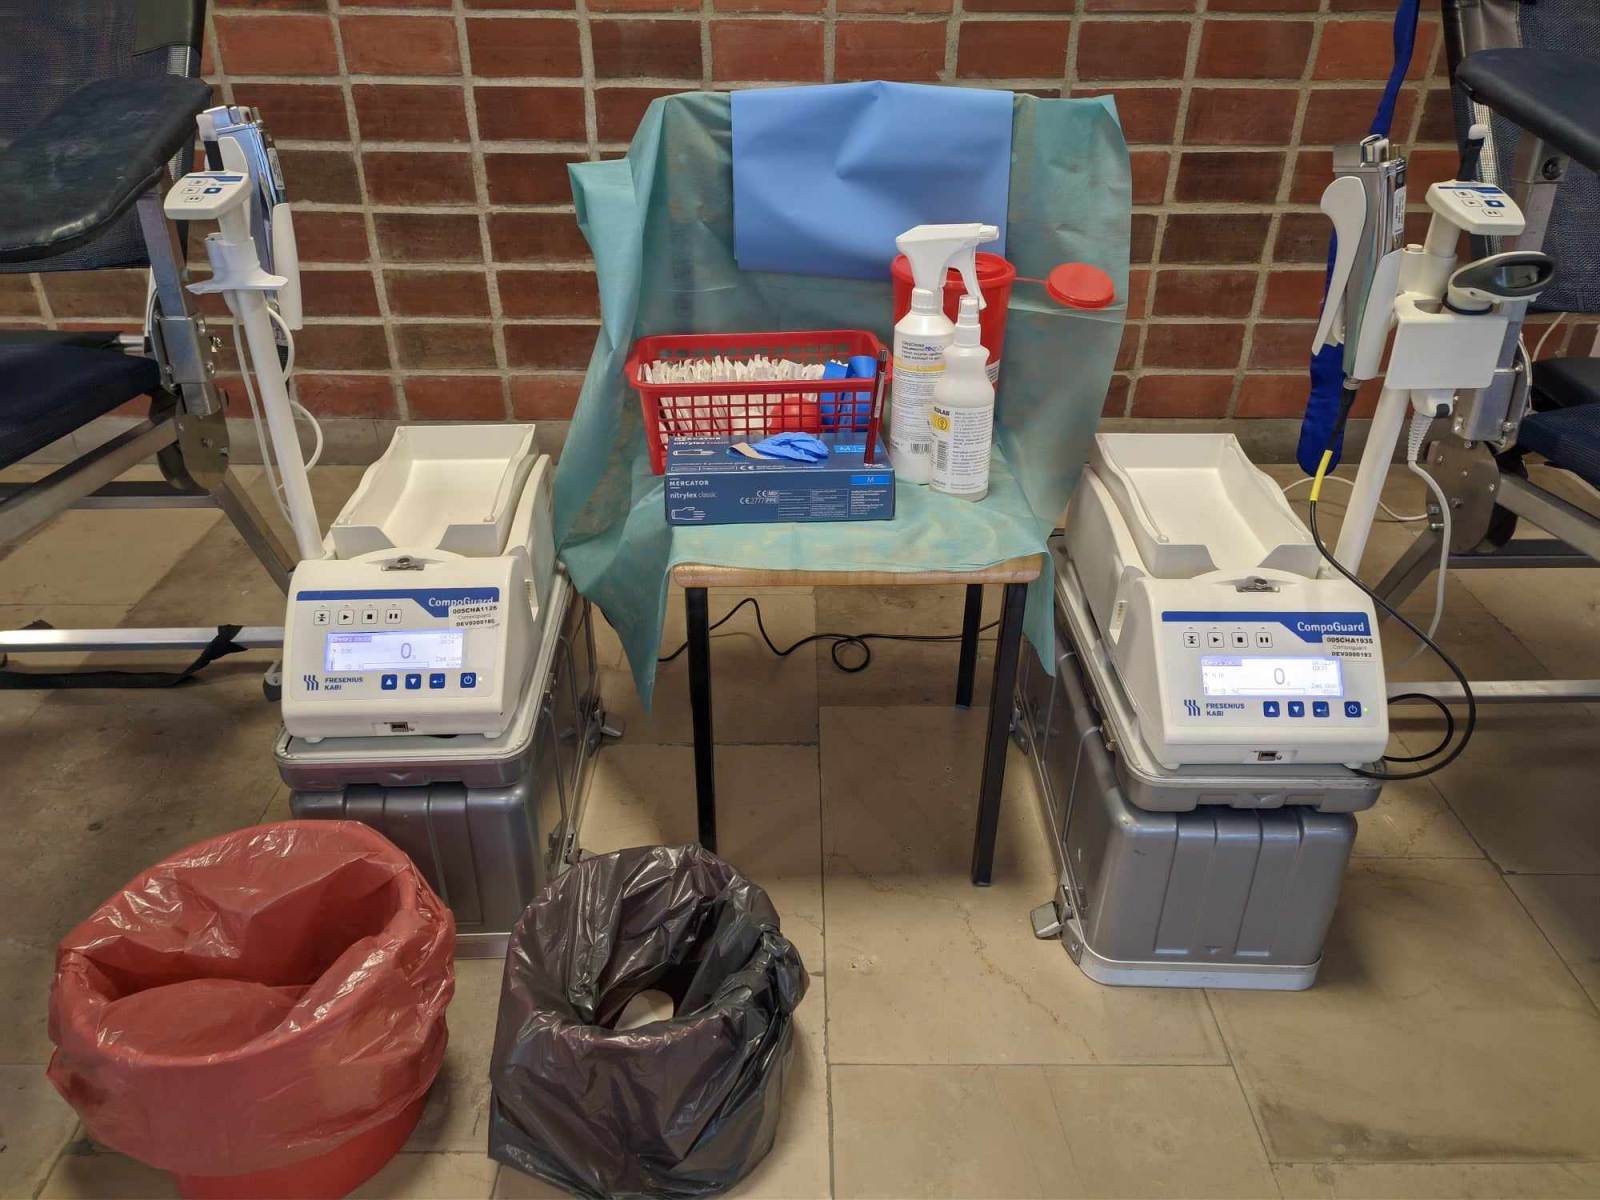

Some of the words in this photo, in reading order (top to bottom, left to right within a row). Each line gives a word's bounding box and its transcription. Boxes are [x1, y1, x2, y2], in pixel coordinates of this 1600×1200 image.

[669, 492, 697, 500] nitrylex
[1296, 621, 1365, 633] CompoGuard
[400, 642, 413, 660] 0
[324, 676, 364, 684] FRESENIUS
[1273, 667, 1286, 685] 0
[1205, 702, 1246, 710] FRESENIUS
